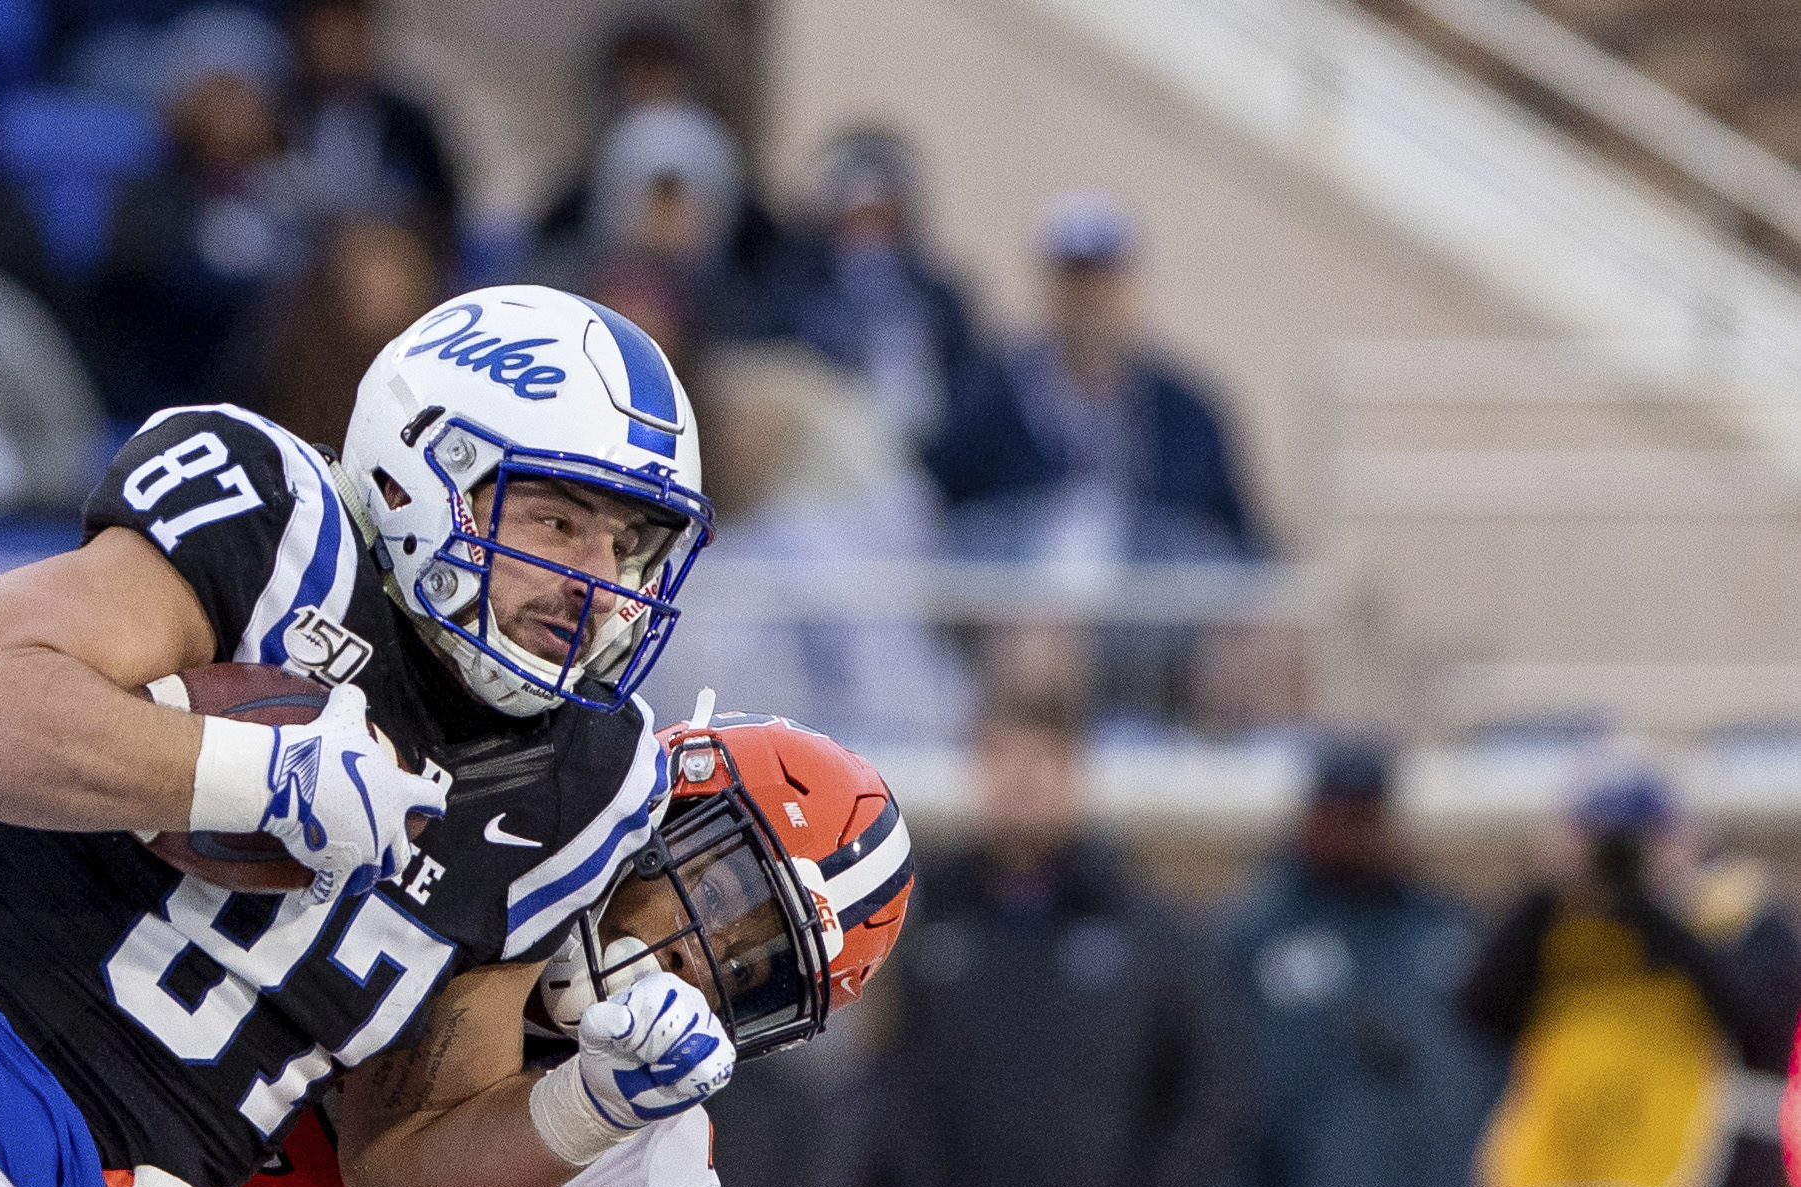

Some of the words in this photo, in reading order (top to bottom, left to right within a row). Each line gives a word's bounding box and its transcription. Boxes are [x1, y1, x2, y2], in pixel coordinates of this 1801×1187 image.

[400, 303, 566, 400] Duke
[123, 431, 265, 554] 87
[294, 608, 373, 688] 150
[782, 801, 809, 829] NIKE
[809, 889, 838, 934] ACC
[100, 868, 458, 1141] 87
